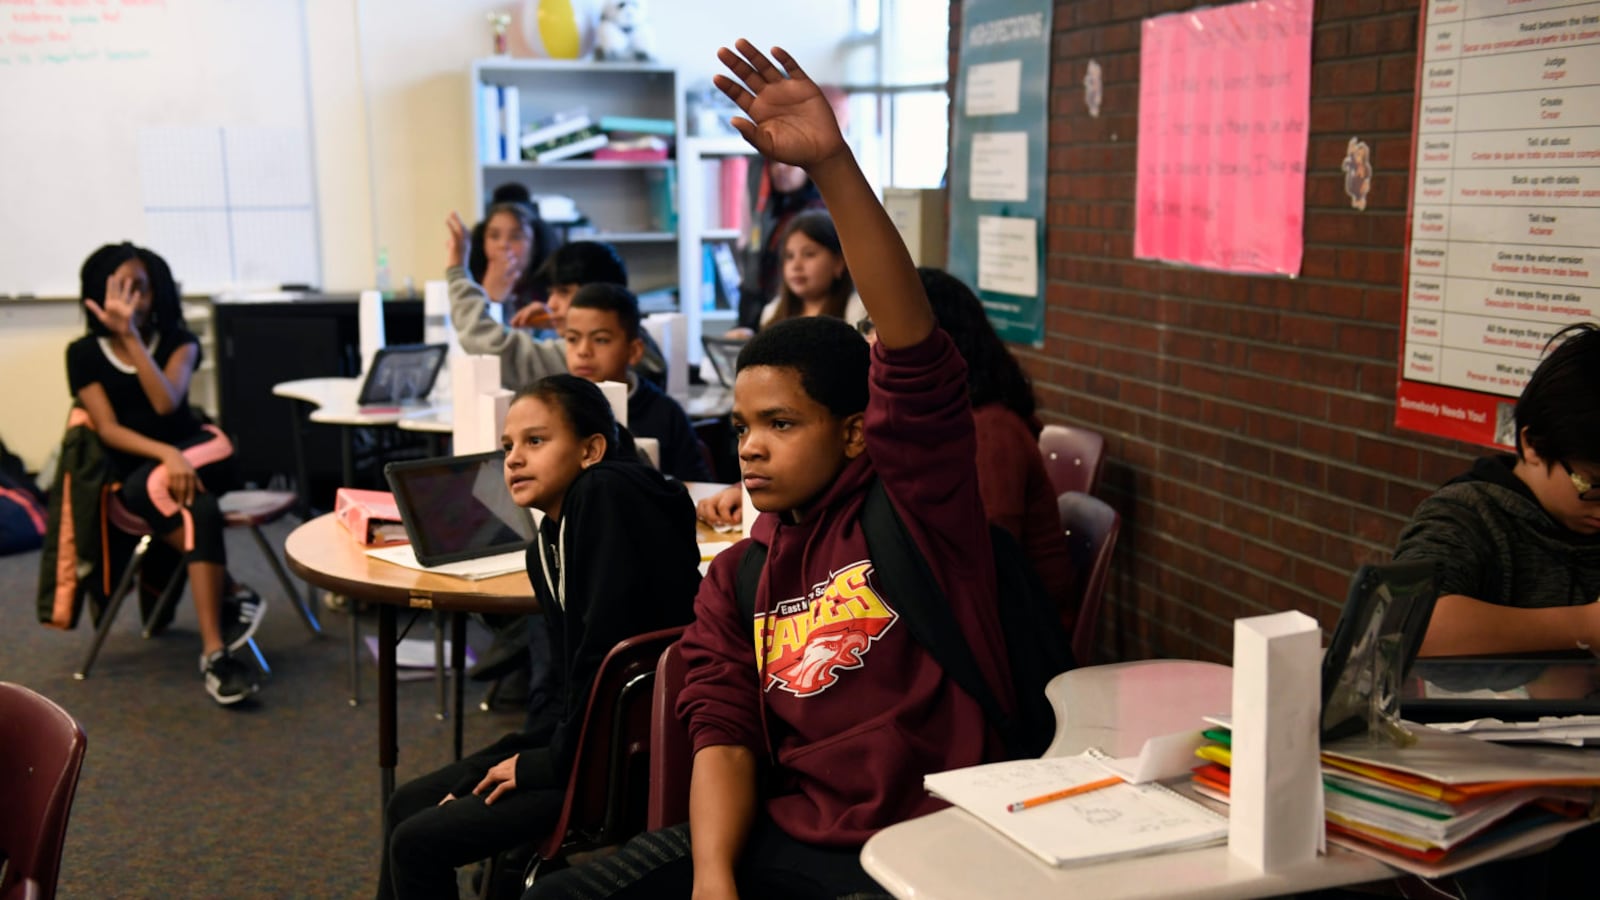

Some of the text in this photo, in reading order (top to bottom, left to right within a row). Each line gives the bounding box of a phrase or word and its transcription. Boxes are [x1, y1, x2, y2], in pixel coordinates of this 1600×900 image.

[1544, 57, 1567, 67] Judge
[1540, 97, 1563, 106] Create
[1541, 110, 1561, 119] Crear
[1527, 137, 1571, 146] Tell all about
[1512, 175, 1580, 186] Back up with details
[1528, 213, 1557, 223] Tell how
[1497, 251, 1512, 260] Give
[1525, 253, 1536, 261] the
[1537, 254, 1556, 262] short
[1557, 256, 1583, 264] version
[1495, 287, 1504, 296] All
[1505, 288, 1515, 296] the
[1517, 291, 1534, 300] ways
[1535, 291, 1549, 302] they
[1564, 292, 1581, 302] alike
[1487, 324, 1496, 333] All
[1497, 326, 1507, 334] the
[1509, 328, 1525, 337] ways
[1527, 329, 1541, 339] they
[1496, 363, 1512, 373] What
[1400, 395, 1487, 424] Somebody Needs You!
[781, 602, 801, 615] East
